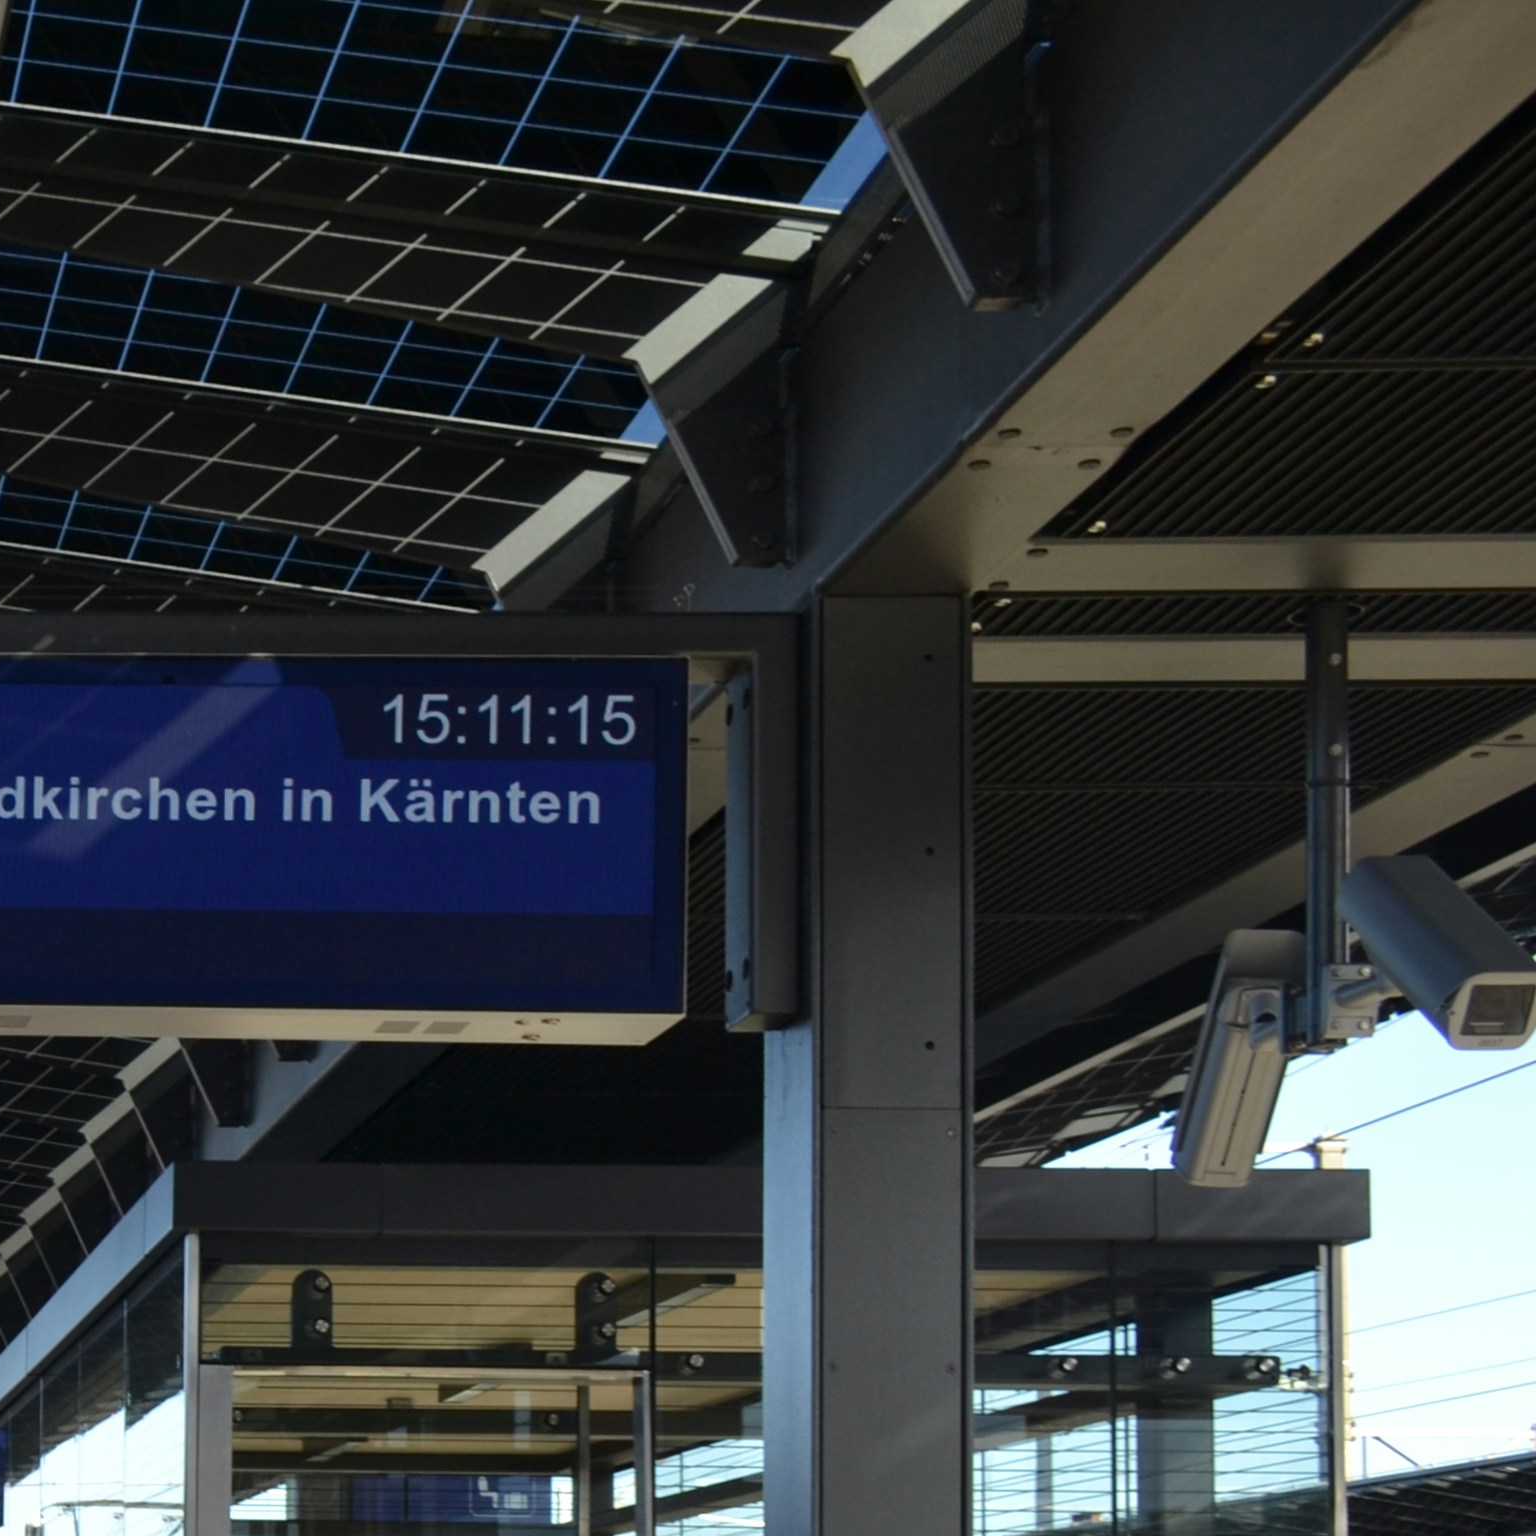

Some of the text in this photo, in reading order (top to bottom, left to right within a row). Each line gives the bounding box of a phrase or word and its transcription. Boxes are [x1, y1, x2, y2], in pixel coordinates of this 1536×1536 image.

[382, 693, 636, 746] 15:11:15
[282, 777, 333, 822] in
[359, 777, 601, 824] Kärnten
